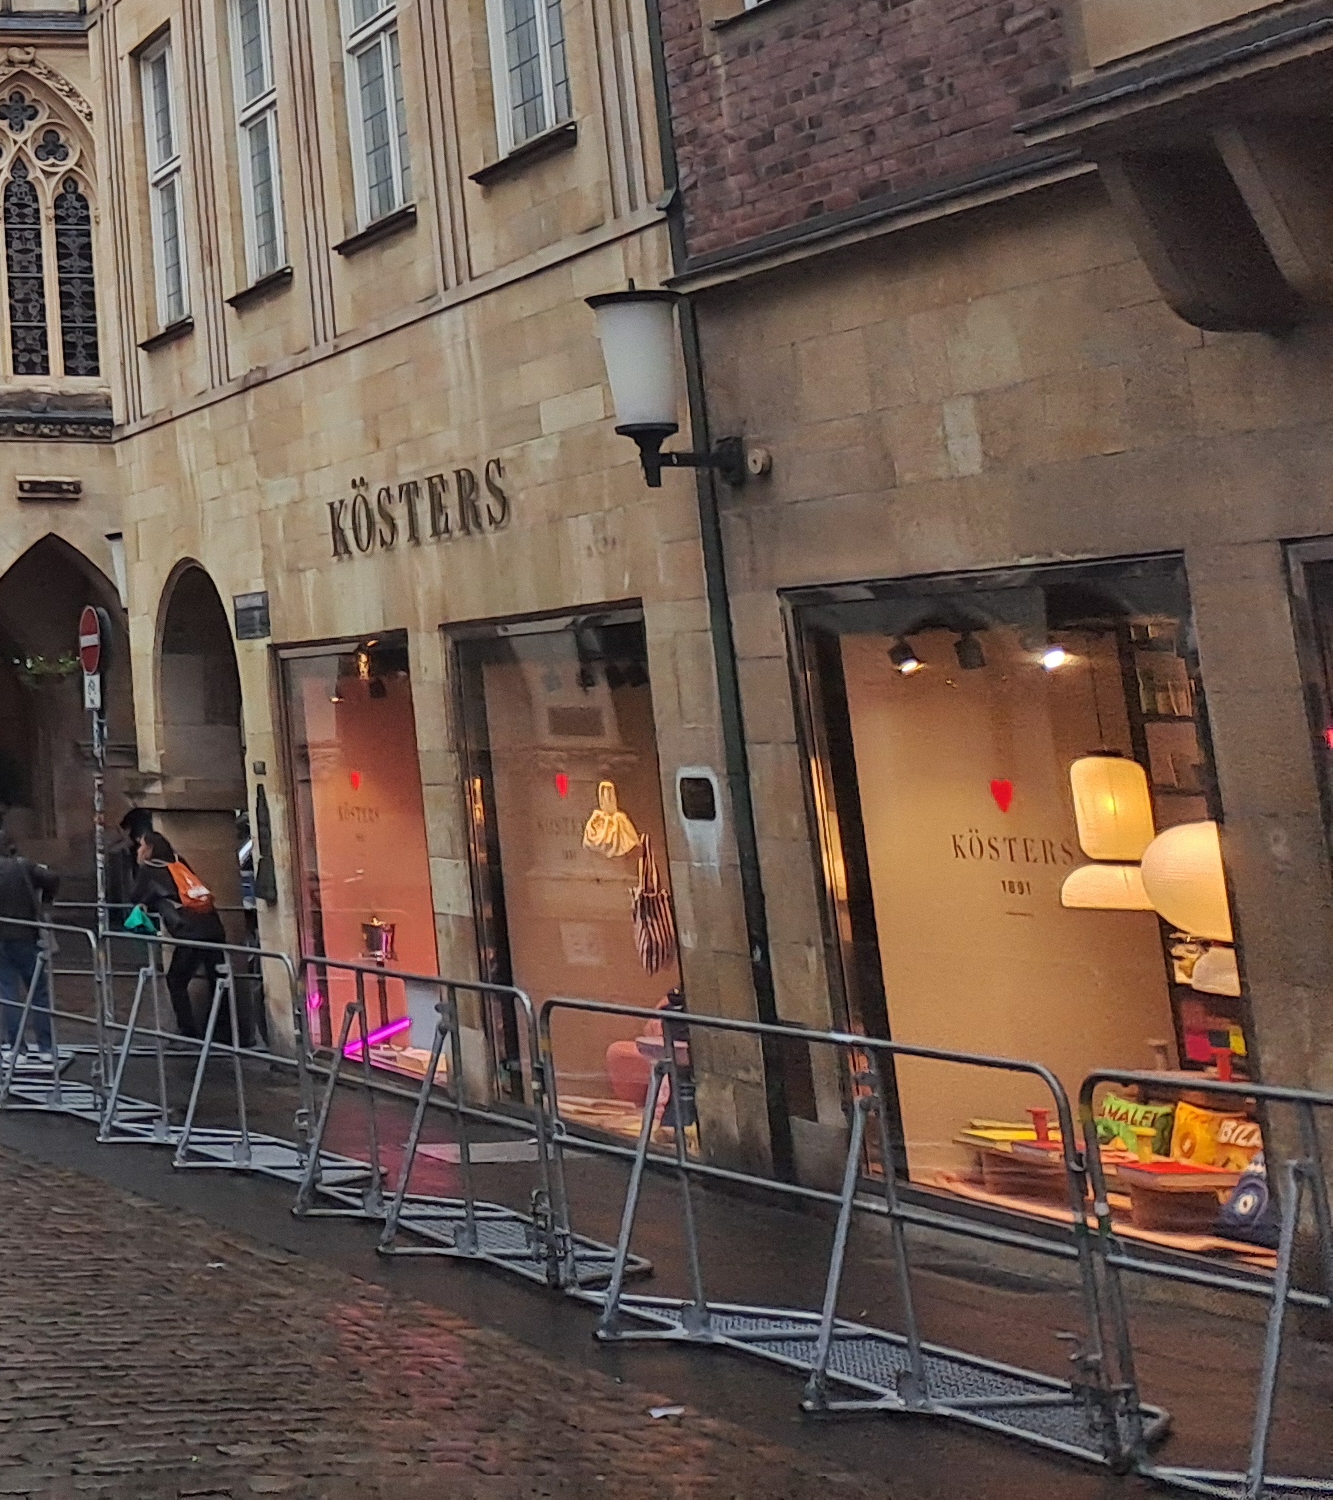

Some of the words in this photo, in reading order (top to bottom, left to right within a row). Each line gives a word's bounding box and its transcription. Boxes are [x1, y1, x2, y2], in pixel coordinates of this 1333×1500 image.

[327, 457, 509, 558] KÖSTERS
[951, 828, 1074, 865] KÖSTERS
[1001, 879, 1031, 895] 1891
